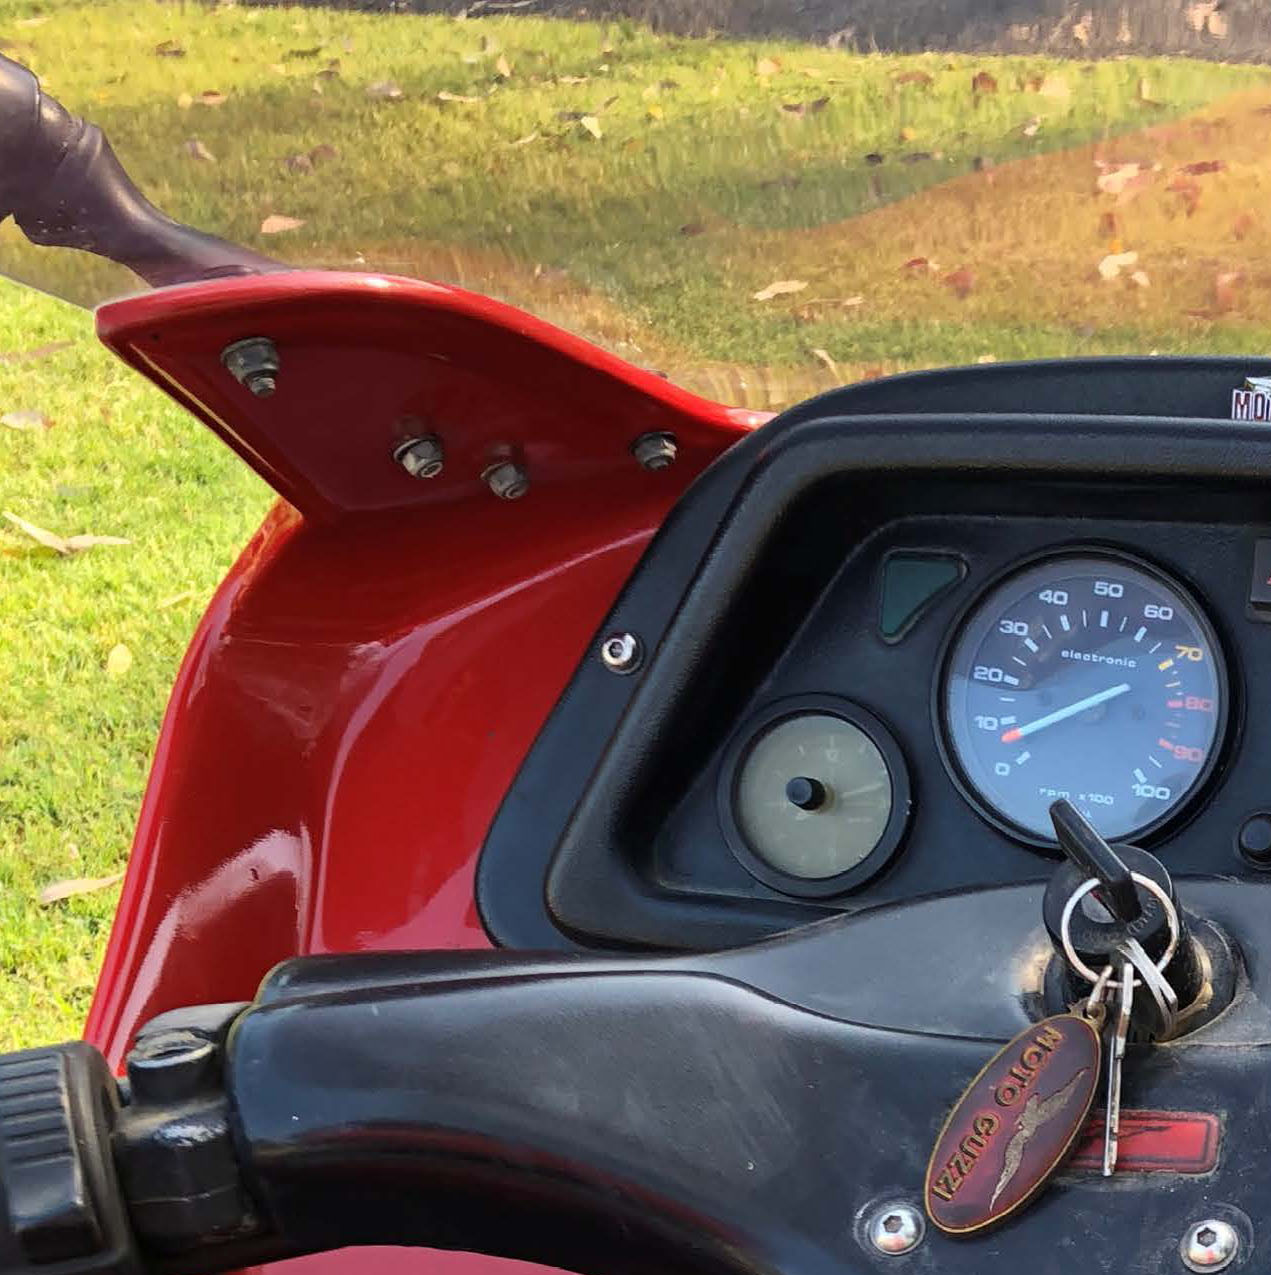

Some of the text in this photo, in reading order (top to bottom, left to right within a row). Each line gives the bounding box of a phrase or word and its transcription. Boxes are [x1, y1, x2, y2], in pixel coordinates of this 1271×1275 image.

[1039, 590, 1068, 606] 40
[1094, 582, 1124, 598] 50
[1144, 604, 1173, 620] 60
[1000, 620, 1029, 636] 30
[1061, 649, 1137, 668] electronic
[1175, 645, 1203, 661] 70
[973, 665, 1003, 681] 20
[1185, 697, 1213, 712] 80
[974, 715, 998, 730] 10
[1173, 746, 1202, 762] 90
[995, 763, 1010, 776] 0
[1078, 793, 1114, 805] x100
[1132, 783, 1171, 801] 100
[931, 1024, 1065, 1201] MOTO GUZZI
